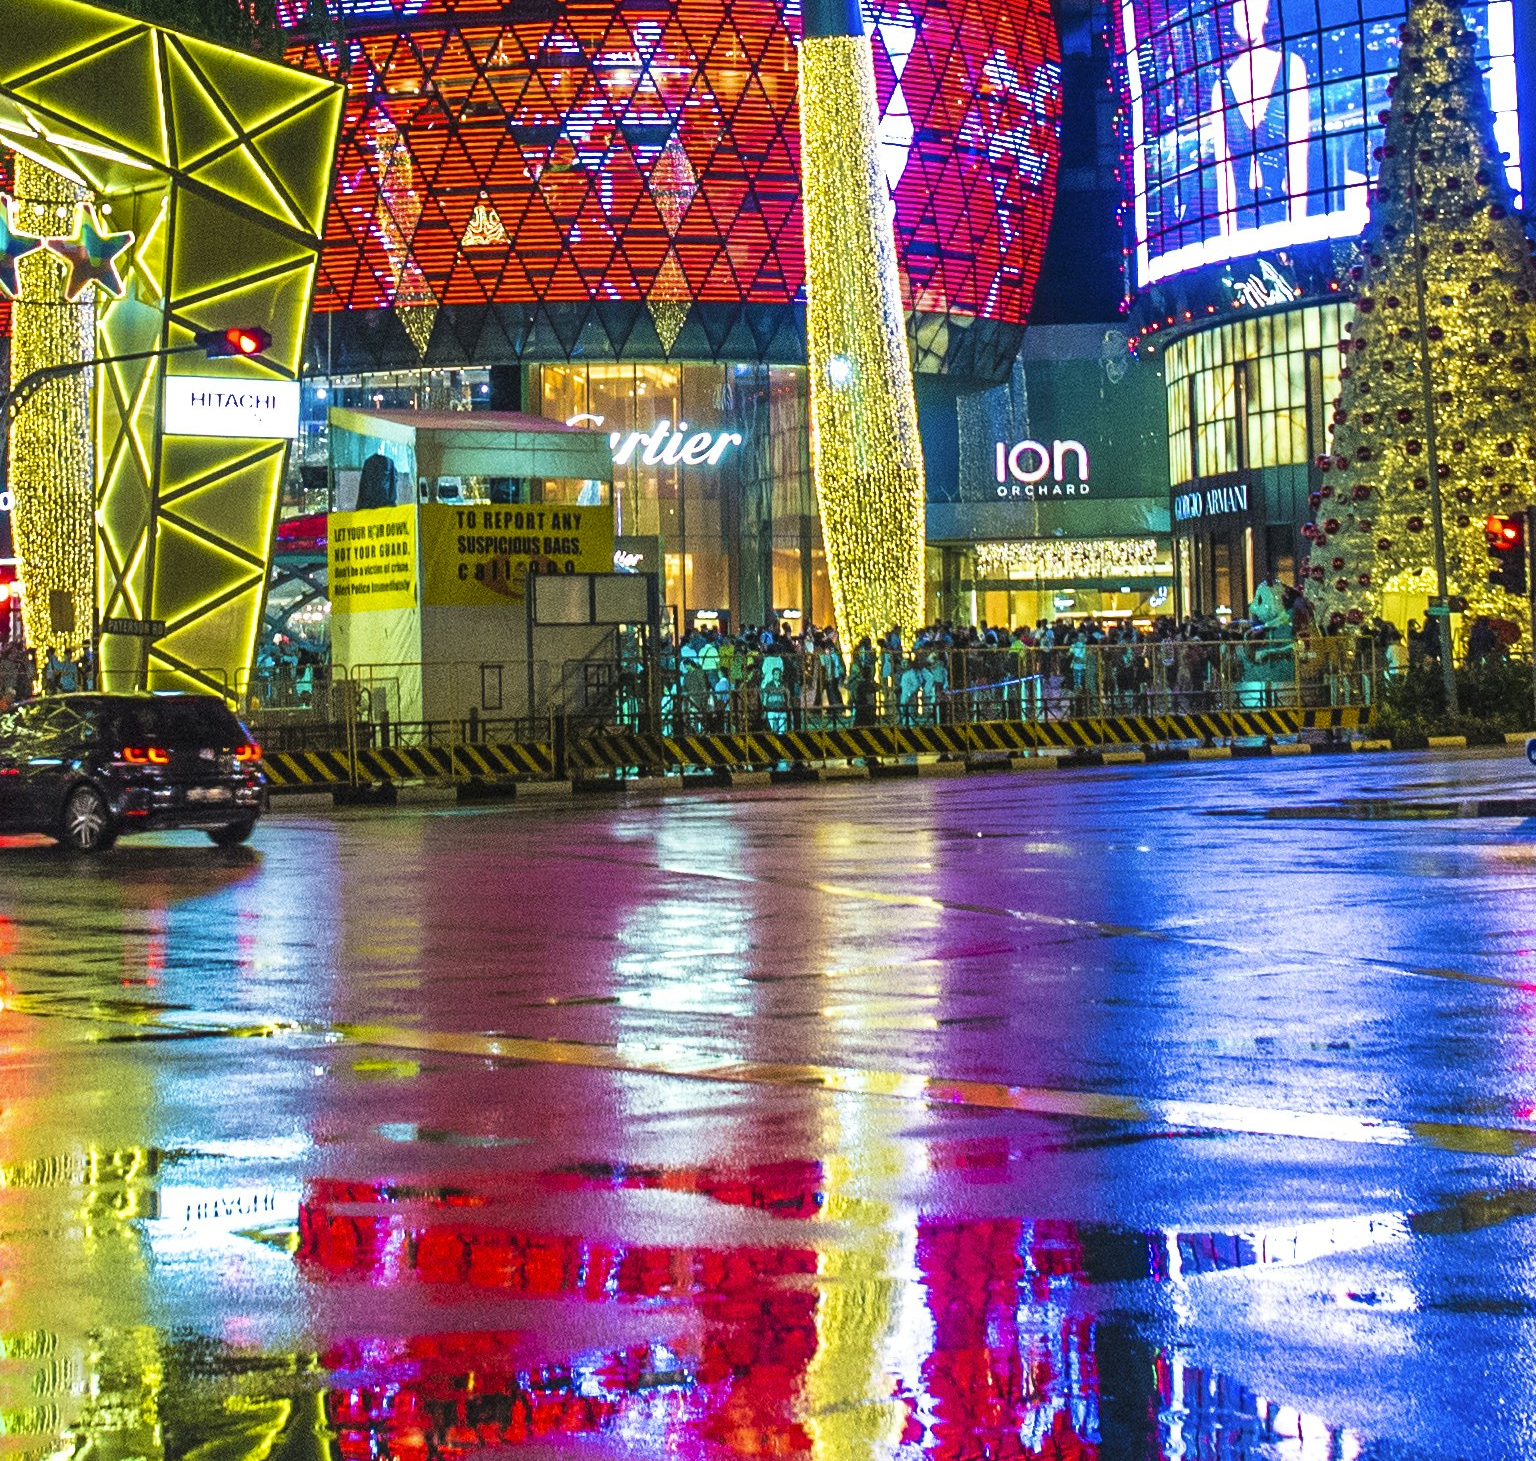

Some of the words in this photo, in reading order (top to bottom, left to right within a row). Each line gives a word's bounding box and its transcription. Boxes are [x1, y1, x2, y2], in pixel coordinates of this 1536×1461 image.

[191, 392, 276, 409] HITACHI
[996, 484, 1090, 497] ORCHARD
[1205, 485, 1248, 516] ARMANI
[456, 511, 477, 529] TO
[483, 511, 546, 530] REPORT
[551, 512, 582, 530] ANY
[334, 547, 351, 562] NOT
[354, 545, 376, 559] YOUR
[457, 535, 541, 554] SUSPICIOUS
